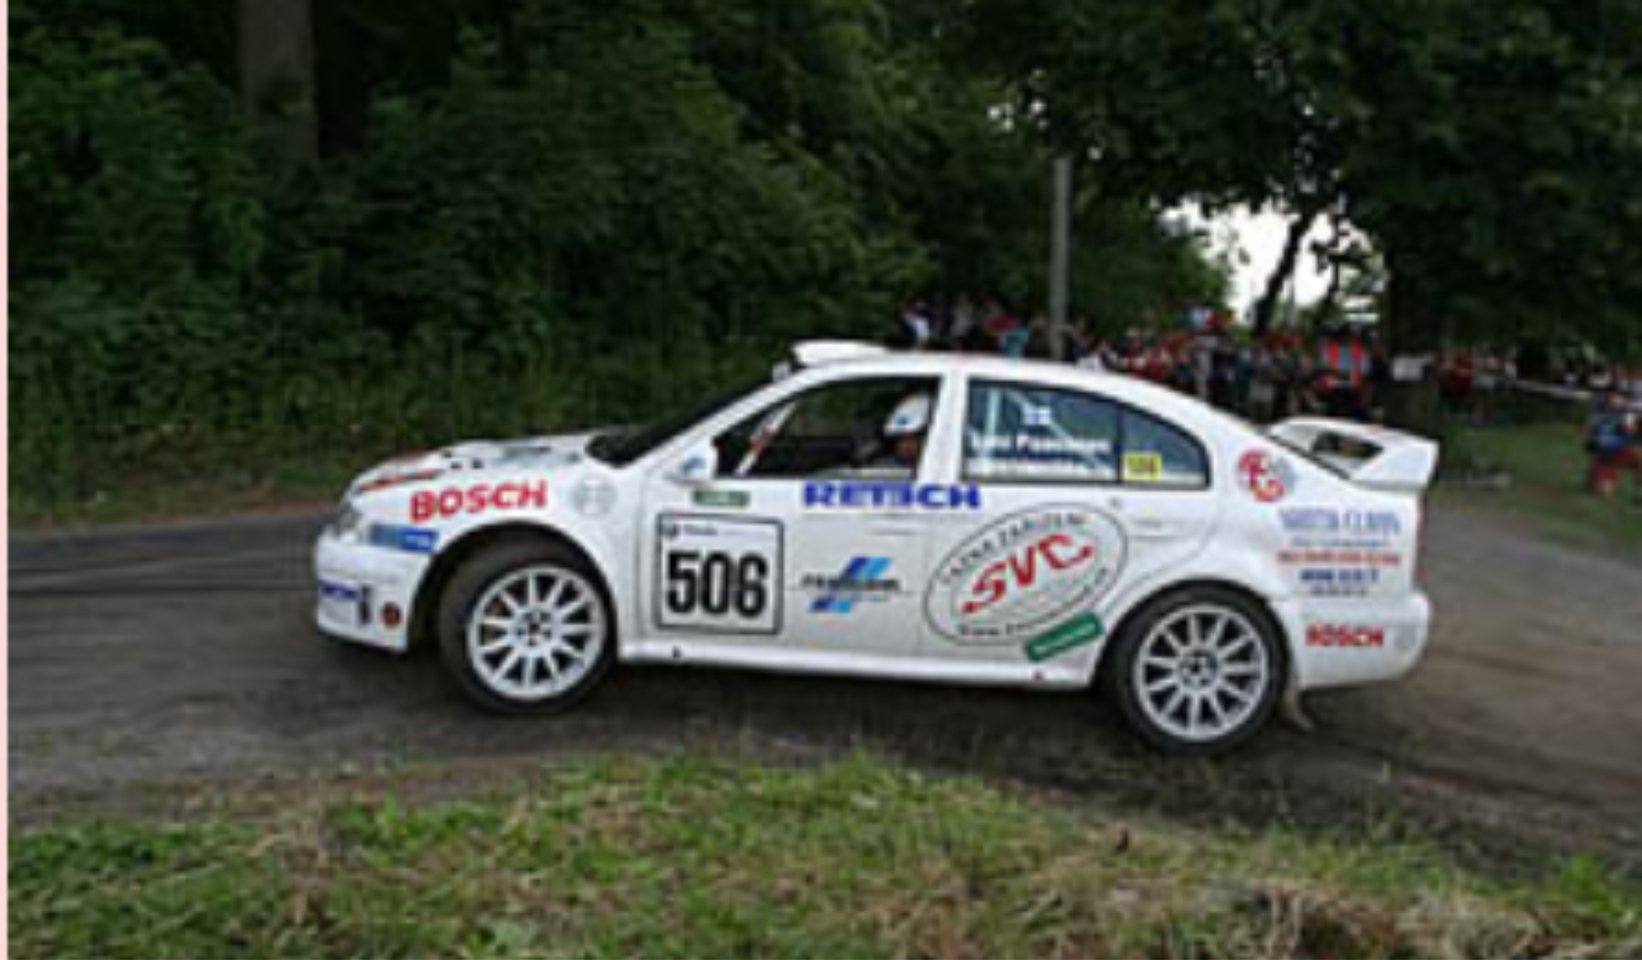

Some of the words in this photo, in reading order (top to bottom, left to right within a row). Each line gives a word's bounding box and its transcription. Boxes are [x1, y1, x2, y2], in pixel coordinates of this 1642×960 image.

[410, 480, 548, 522] BOSCH
[666, 551, 768, 618] 506
[961, 533, 1095, 614] SVC
